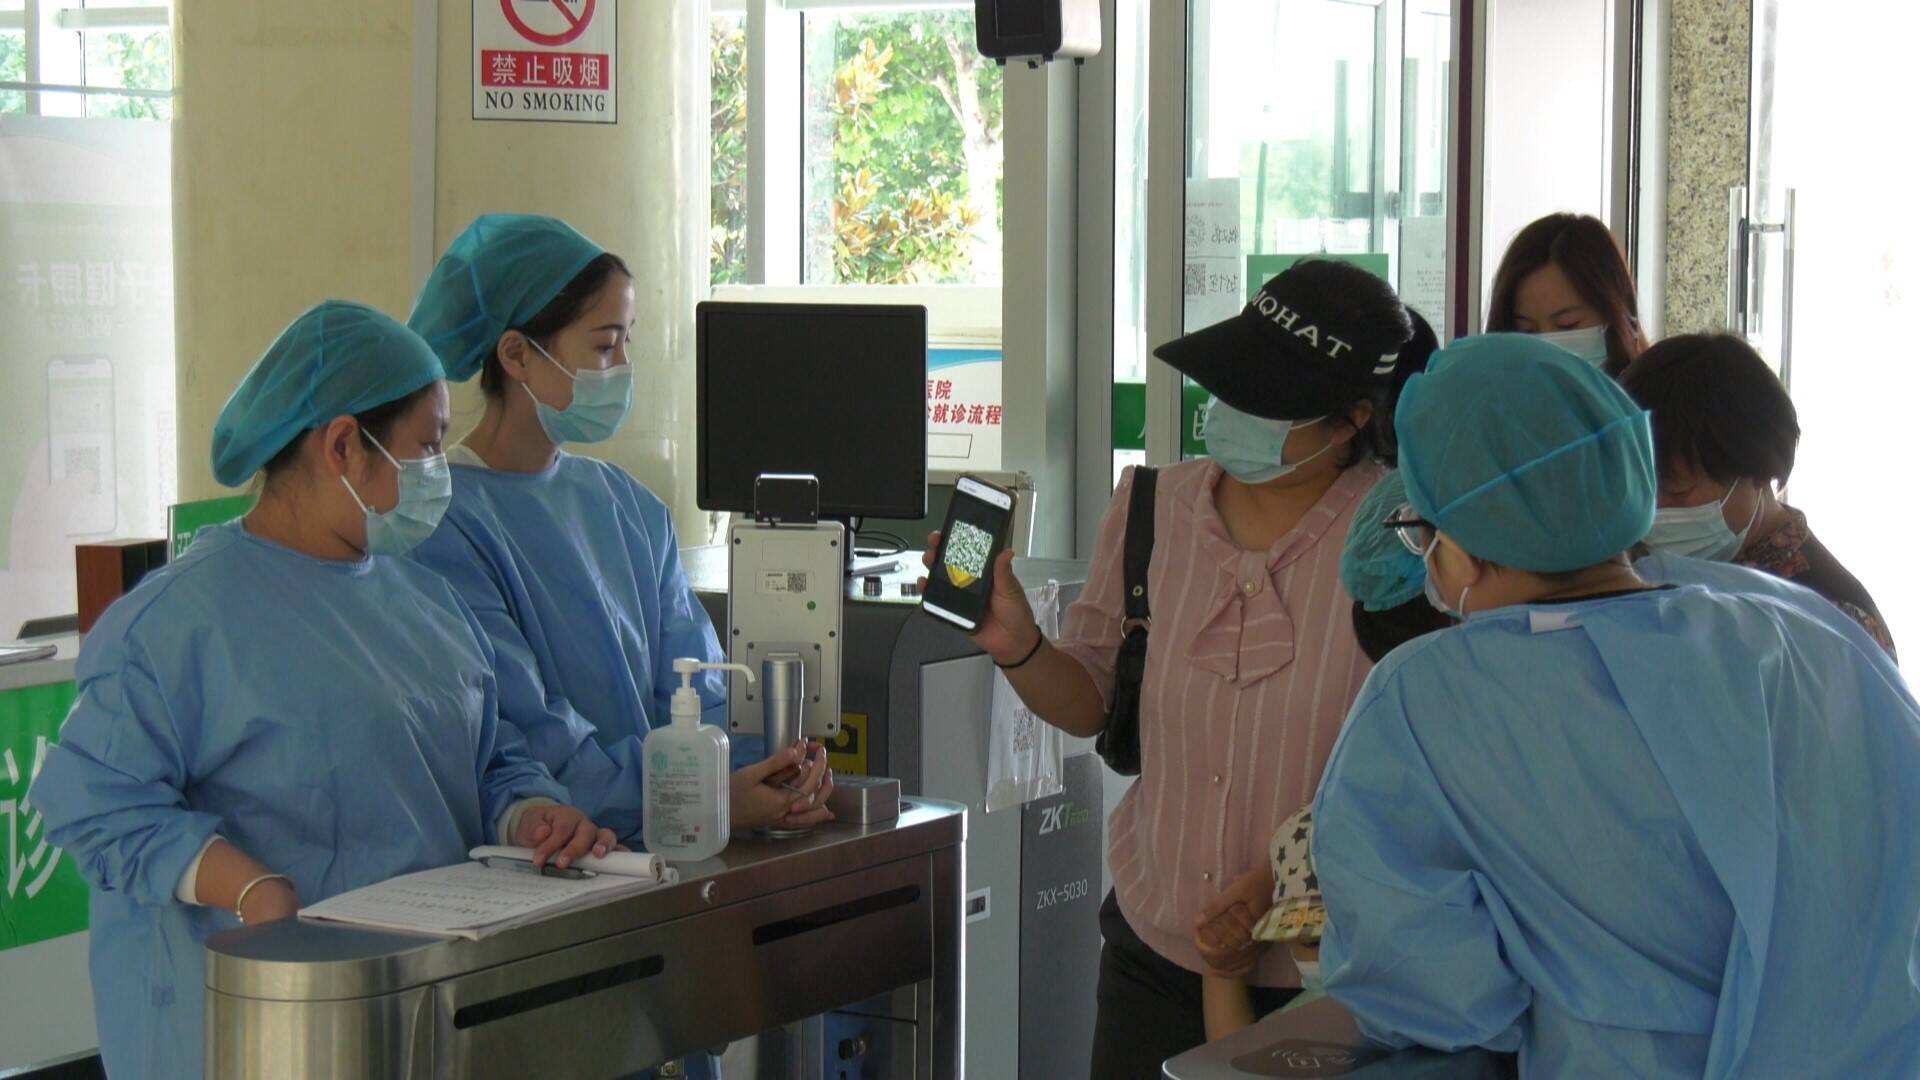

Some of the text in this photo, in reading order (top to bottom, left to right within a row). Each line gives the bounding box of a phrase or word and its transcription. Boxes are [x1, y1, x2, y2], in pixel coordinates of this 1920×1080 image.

[492, 54, 600, 86] 禁止吸烟
[485, 91, 605, 112] NO SMOKING
[928, 403, 1002, 425] 就诊流程
[1037, 878, 1088, 910] ZKX-5030
